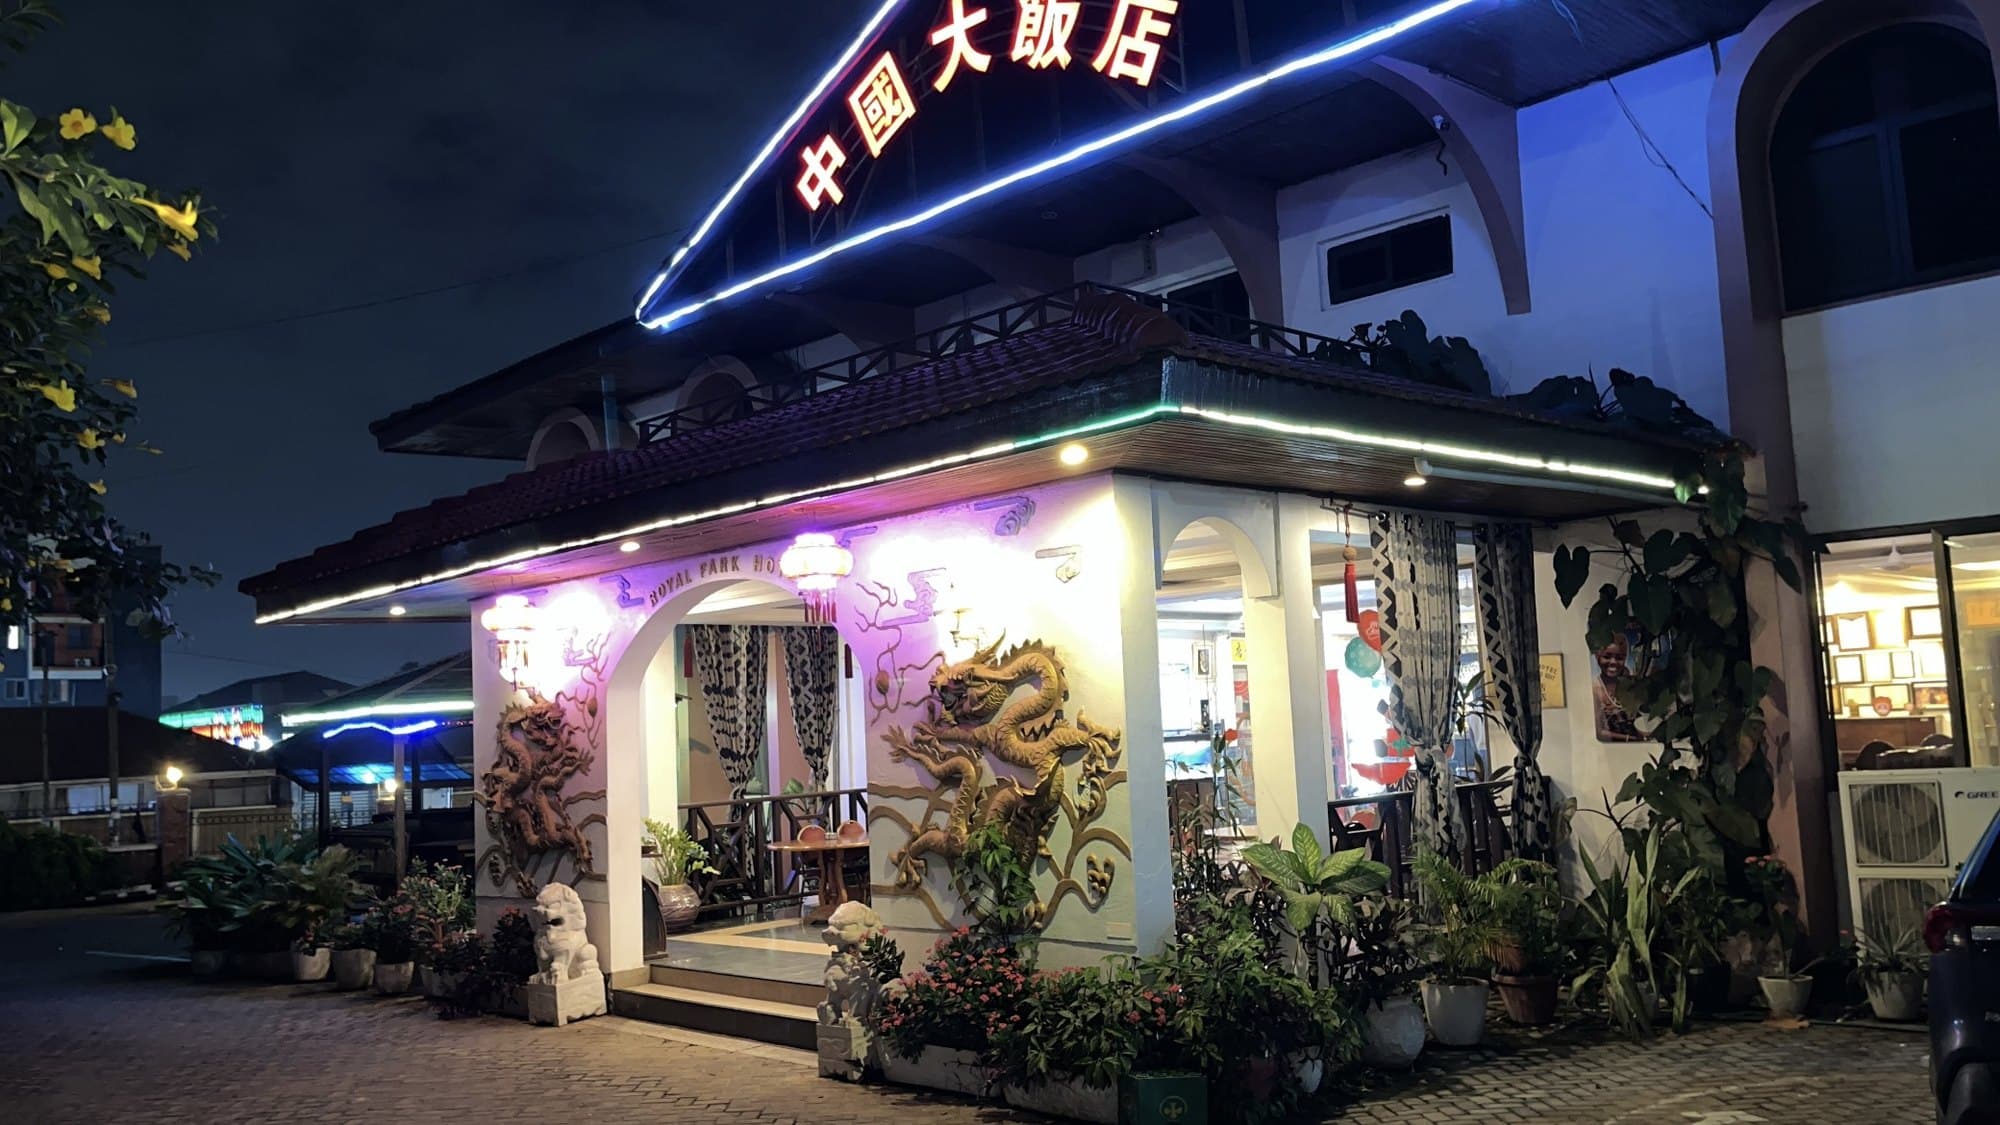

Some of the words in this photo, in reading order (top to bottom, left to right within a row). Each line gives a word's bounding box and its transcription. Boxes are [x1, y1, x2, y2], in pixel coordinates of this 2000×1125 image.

[796, 0, 1178, 211] 中國大飯店
[649, 569, 693, 607] ROYAL
[700, 556, 740, 578] PARK
[1967, 791, 1999, 799] GREE
